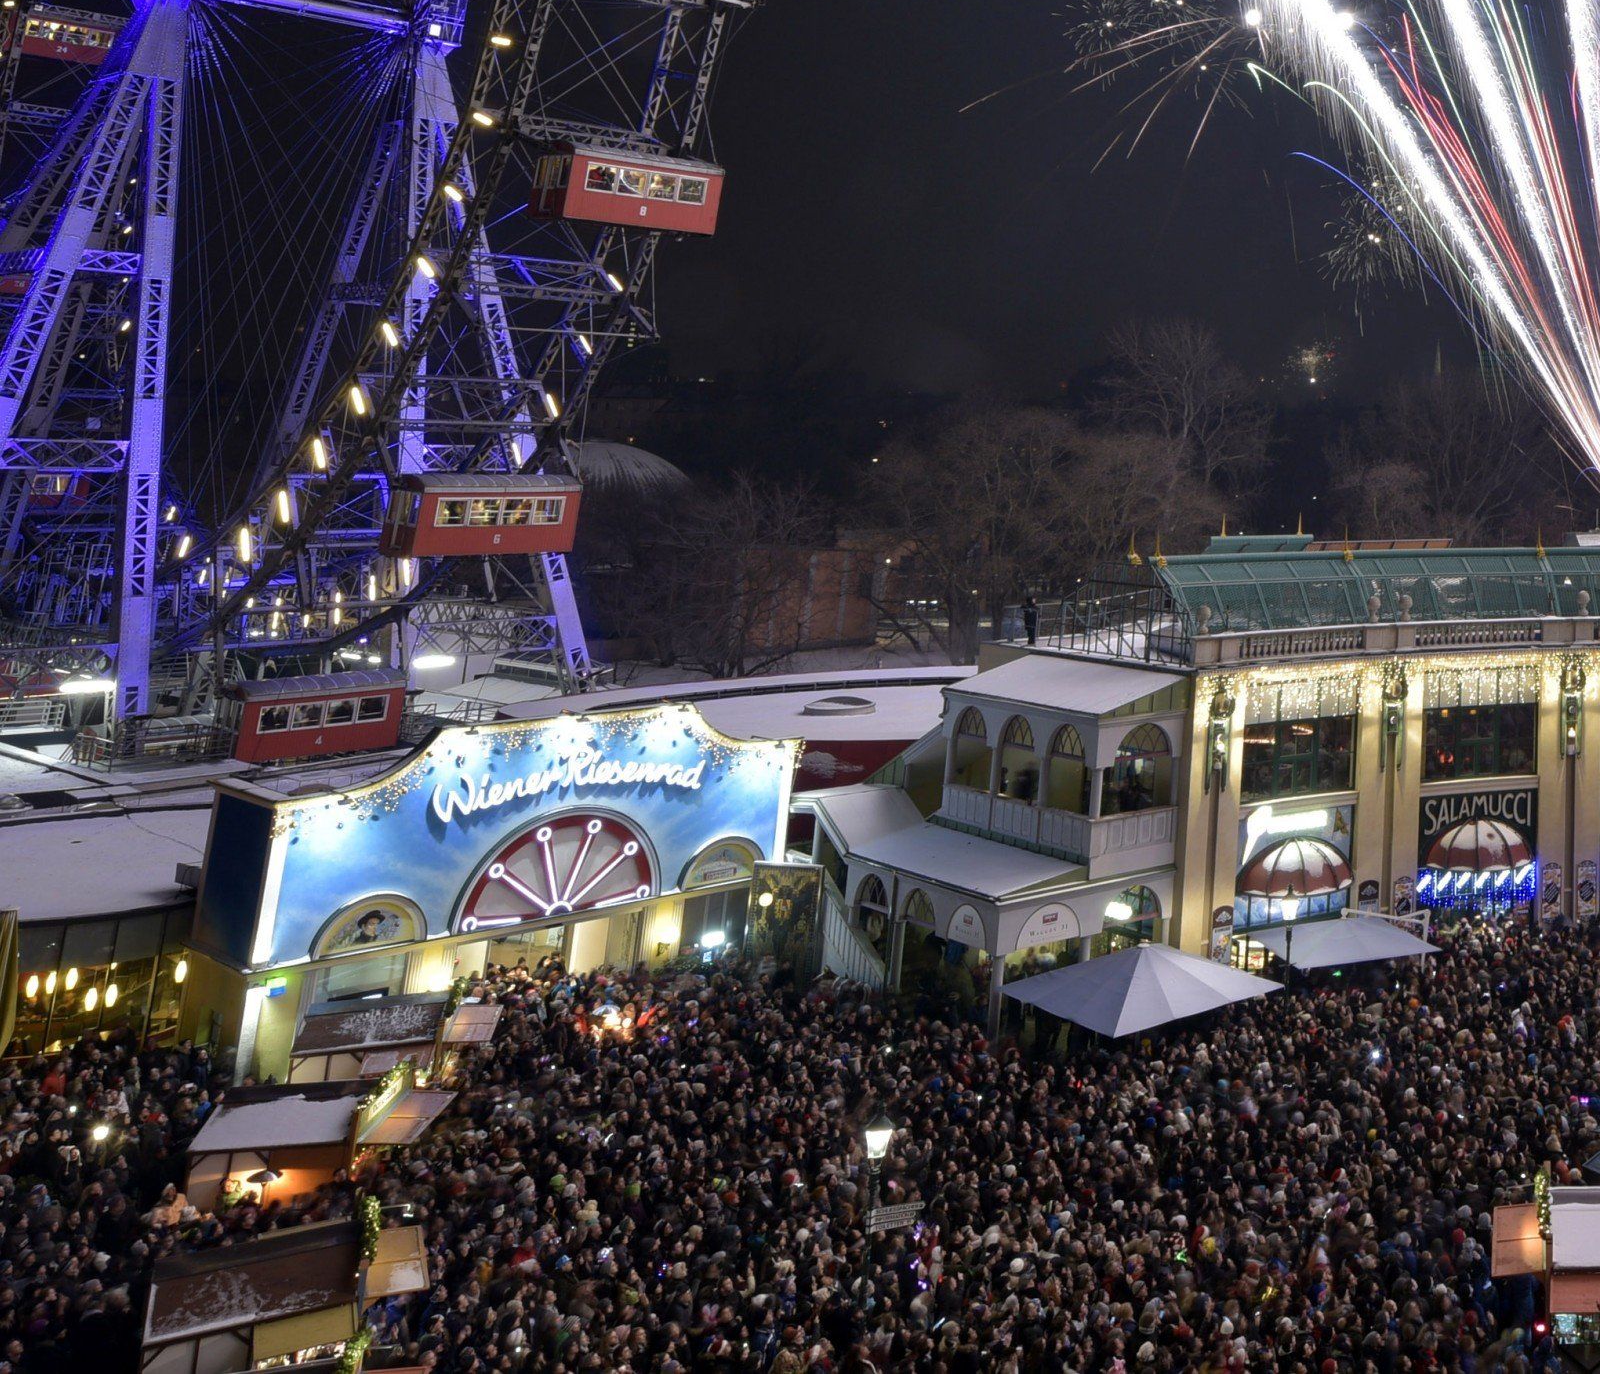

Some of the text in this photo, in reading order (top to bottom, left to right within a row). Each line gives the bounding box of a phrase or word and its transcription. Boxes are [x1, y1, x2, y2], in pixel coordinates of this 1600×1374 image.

[639, 205, 648, 216] 8
[493, 534, 501, 544] 6
[314, 735, 322, 745] 4
[433, 745, 706, 823] Wiener Riesenrad
[1424, 791, 1532, 836] SALAMUCCI
